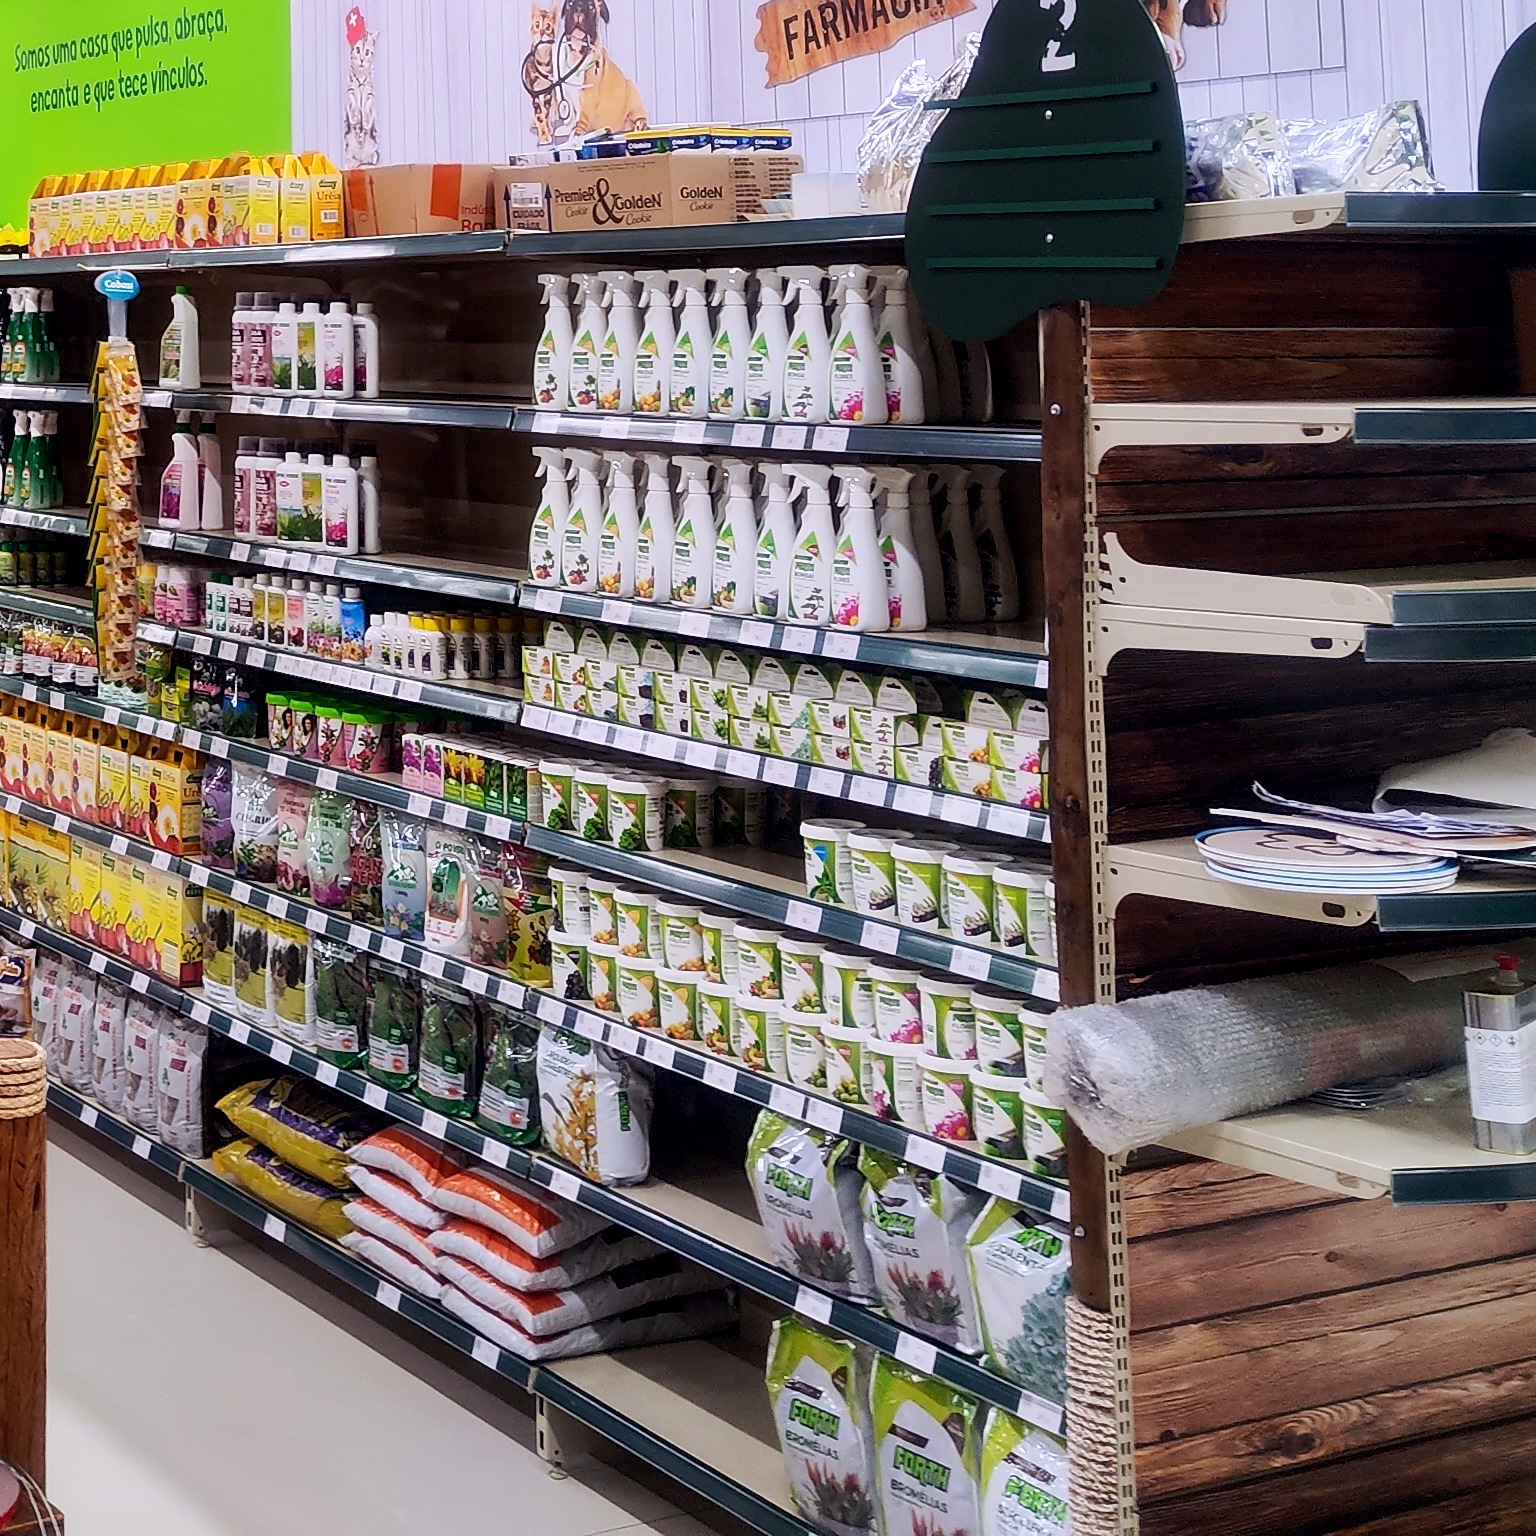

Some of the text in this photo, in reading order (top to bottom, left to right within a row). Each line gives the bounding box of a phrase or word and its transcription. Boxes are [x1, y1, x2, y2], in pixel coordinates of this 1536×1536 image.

[15, 7, 228, 72] Somos uma casa que pulsa, abraça,
[30, 56, 208, 112] encanta e que tece vínculos.
[680, 186, 723, 199] GoldeN
[104, 279, 134, 290] Cobasi
[789, 1398, 840, 1440] FORTH
[785, 1430, 839, 1460] BROMÉLIAS
[893, 1445, 951, 1493] FORTH
[890, 1479, 948, 1513] BROMÉLIAS
